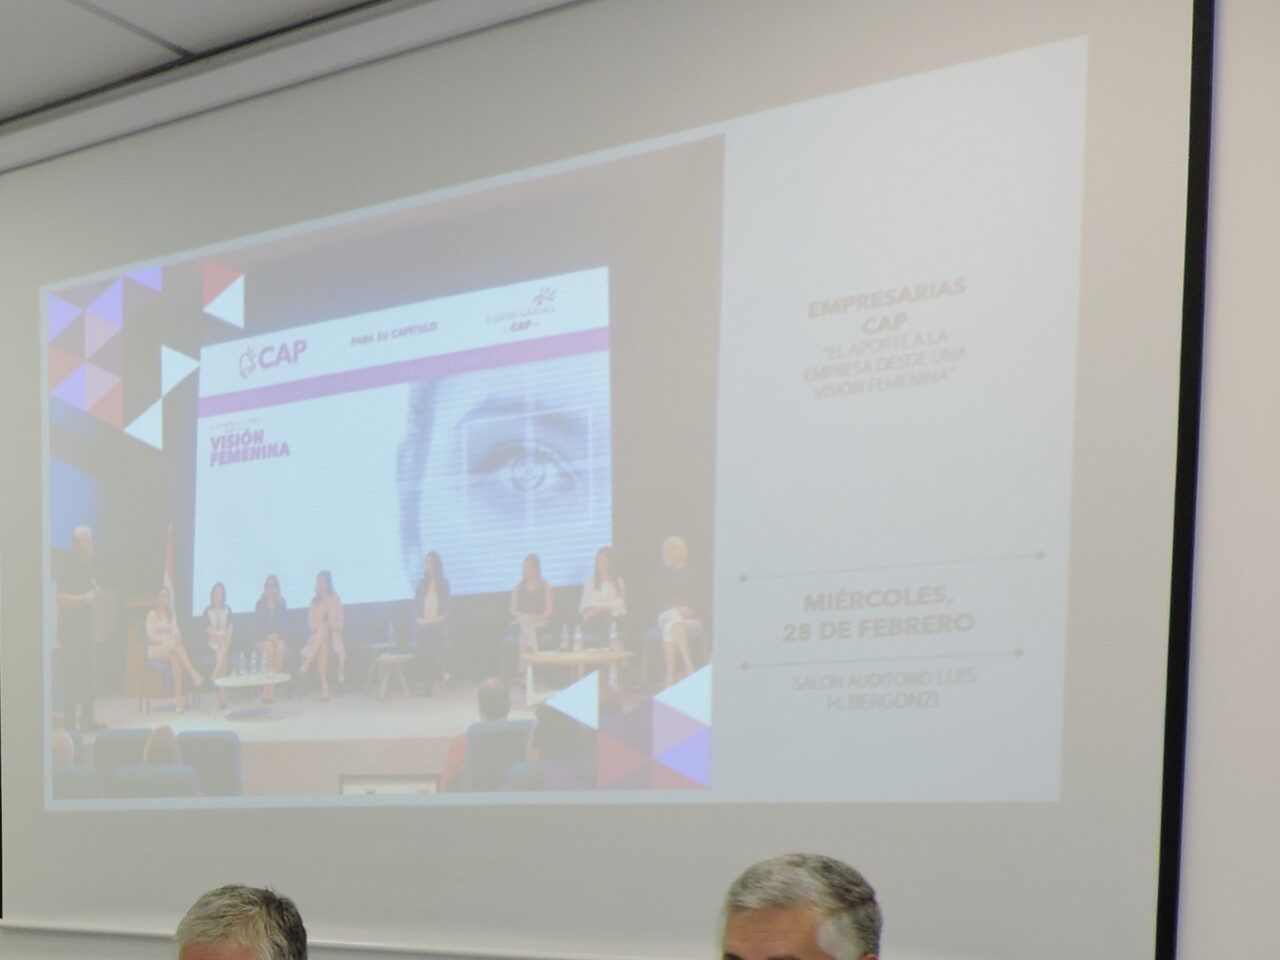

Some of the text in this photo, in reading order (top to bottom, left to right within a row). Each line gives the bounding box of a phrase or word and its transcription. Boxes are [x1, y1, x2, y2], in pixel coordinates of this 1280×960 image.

[806, 275, 967, 319] EMPRESARIAS
[862, 312, 908, 335] CAP
[258, 340, 307, 369] CAP
[849, 334, 908, 355] APORTE
[913, 332, 925, 347] A
[928, 328, 948, 344] LA
[803, 345, 968, 382] EMPRESA DESDE UNA
[210, 427, 264, 450] VISIÓN
[210, 441, 290, 467] FEMENINA
[803, 585, 955, 613] MIÉRCOLES,
[782, 612, 976, 642] 28 DE FEBRERO
[792, 667, 977, 691] SALON AUDITORIO LUIS
[848, 690, 940, 711] BERGONZI
